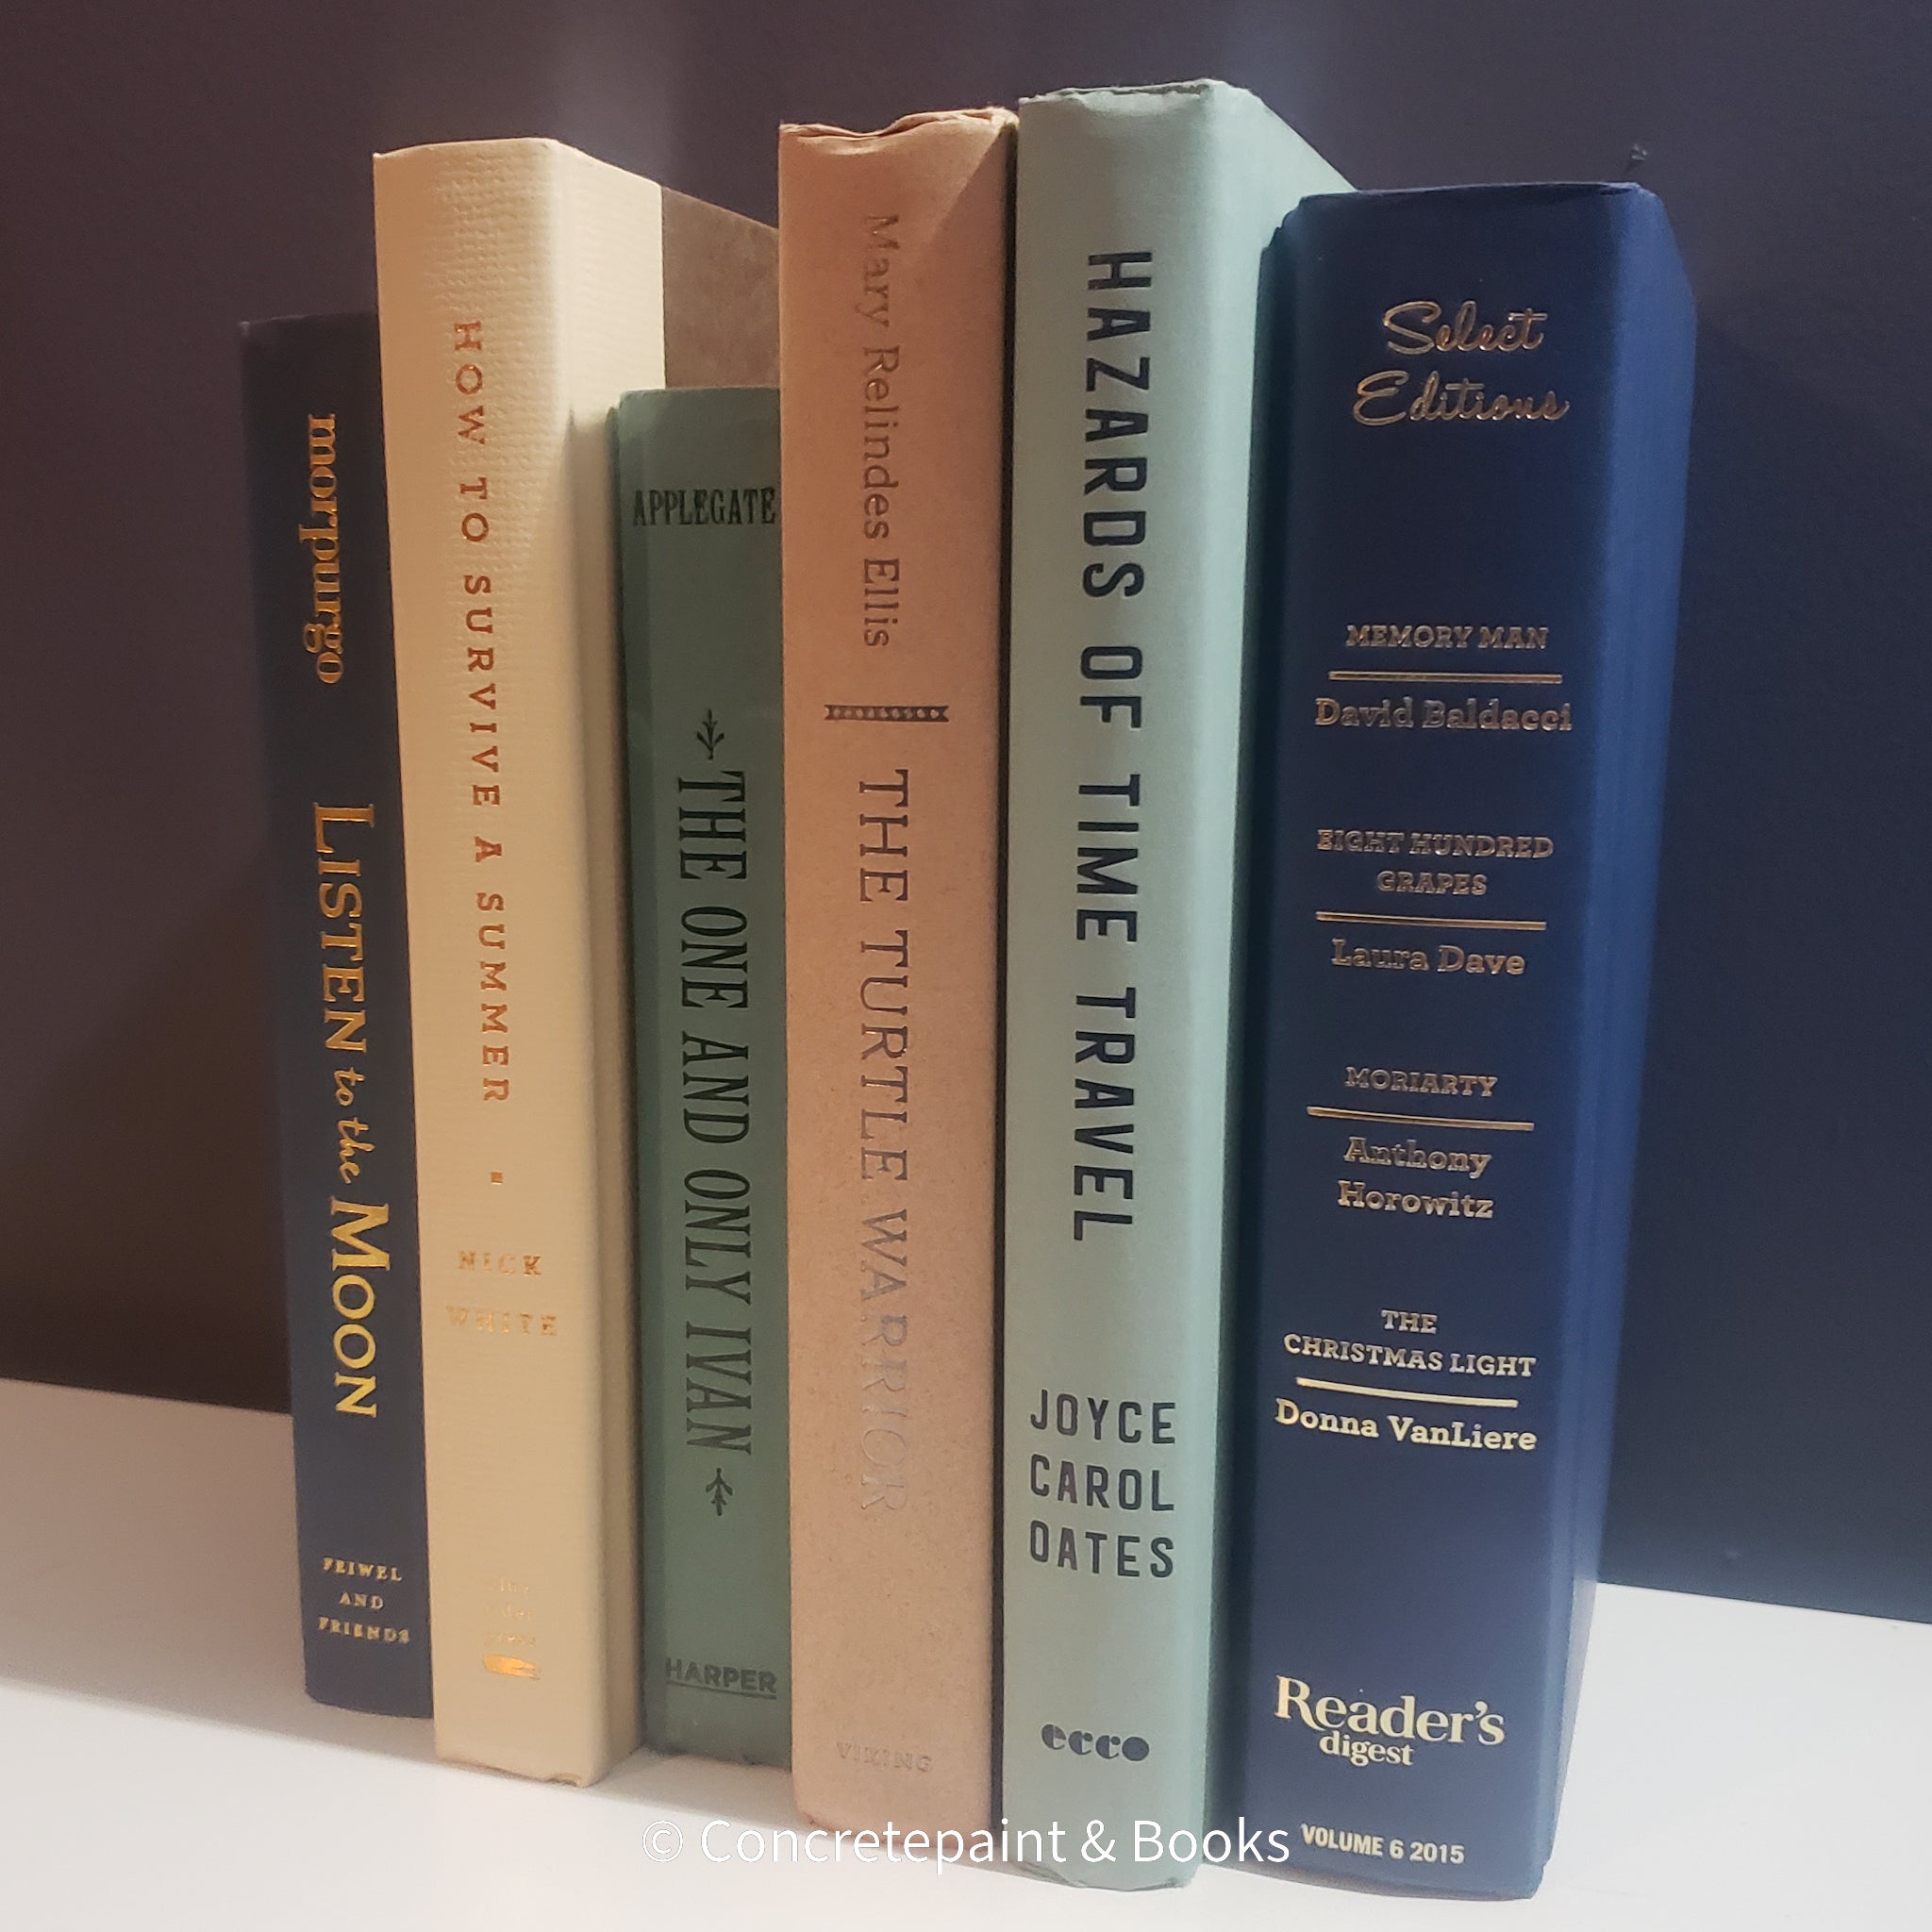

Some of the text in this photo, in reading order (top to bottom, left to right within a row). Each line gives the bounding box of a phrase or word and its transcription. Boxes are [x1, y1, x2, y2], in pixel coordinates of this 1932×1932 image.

[1383, 300, 1548, 356] Select
[1352, 370, 1570, 427] Editions
[855, 214, 901, 648] Mary Relindes Ellis
[632, 488, 777, 526] APPLEGATE
[298, 413, 345, 685] morpurgo
[1345, 624, 1549, 651] MEMORY MAN
[453, 320, 510, 1105] HOW TO SURVIVE A SUMMER
[1314, 697, 1574, 732] David Baldacci
[1073, 251, 1154, 1242] HAZARDS OF TIME TRAVEL
[1317, 828, 1555, 859] EIGHT HUNDRED
[1376, 870, 1488, 896] GRAPES
[314, 803, 375, 1054] LISTEN
[1331, 939, 1526, 975] Laura Dave
[333, 1067, 365, 1107] to
[1344, 1066, 1498, 1097] MORIARTY
[677, 771, 753, 1456] THE ONE AND ONLY IVAN
[336, 1116, 375, 1184] the
[859, 769, 909, 1511] THE TURTLE WARRIOR
[1342, 1136, 1491, 1179] Anthony
[1337, 1180, 1494, 1219] Horowitz
[458, 1250, 542, 1276] NICK
[446, 1306, 558, 1336] WHITE
[1381, 1308, 1438, 1334] THE
[1283, 1334, 1537, 1377] CHRISTMAS LIGHT
[1030, 1389, 1176, 1444] JOYCE
[1274, 1397, 1538, 1452] Donna VanLiere
[1030, 1454, 1175, 1511] CAROL
[1030, 1520, 1175, 1578] OATES
[322, 1557, 403, 1582] FEIWEL
[339, 1592, 385, 1611] AND
[318, 1617, 409, 1644] FRIENDS
[665, 1657, 777, 1694] HARPER
[1275, 1674, 1506, 1746] Reader's
[837, 1740, 933, 1774] VIKING
[1041, 1723, 1150, 1762] ecco
[1319, 1729, 1414, 1768] digest
[1301, 1824, 1465, 1865] VOLUME 6 2015
